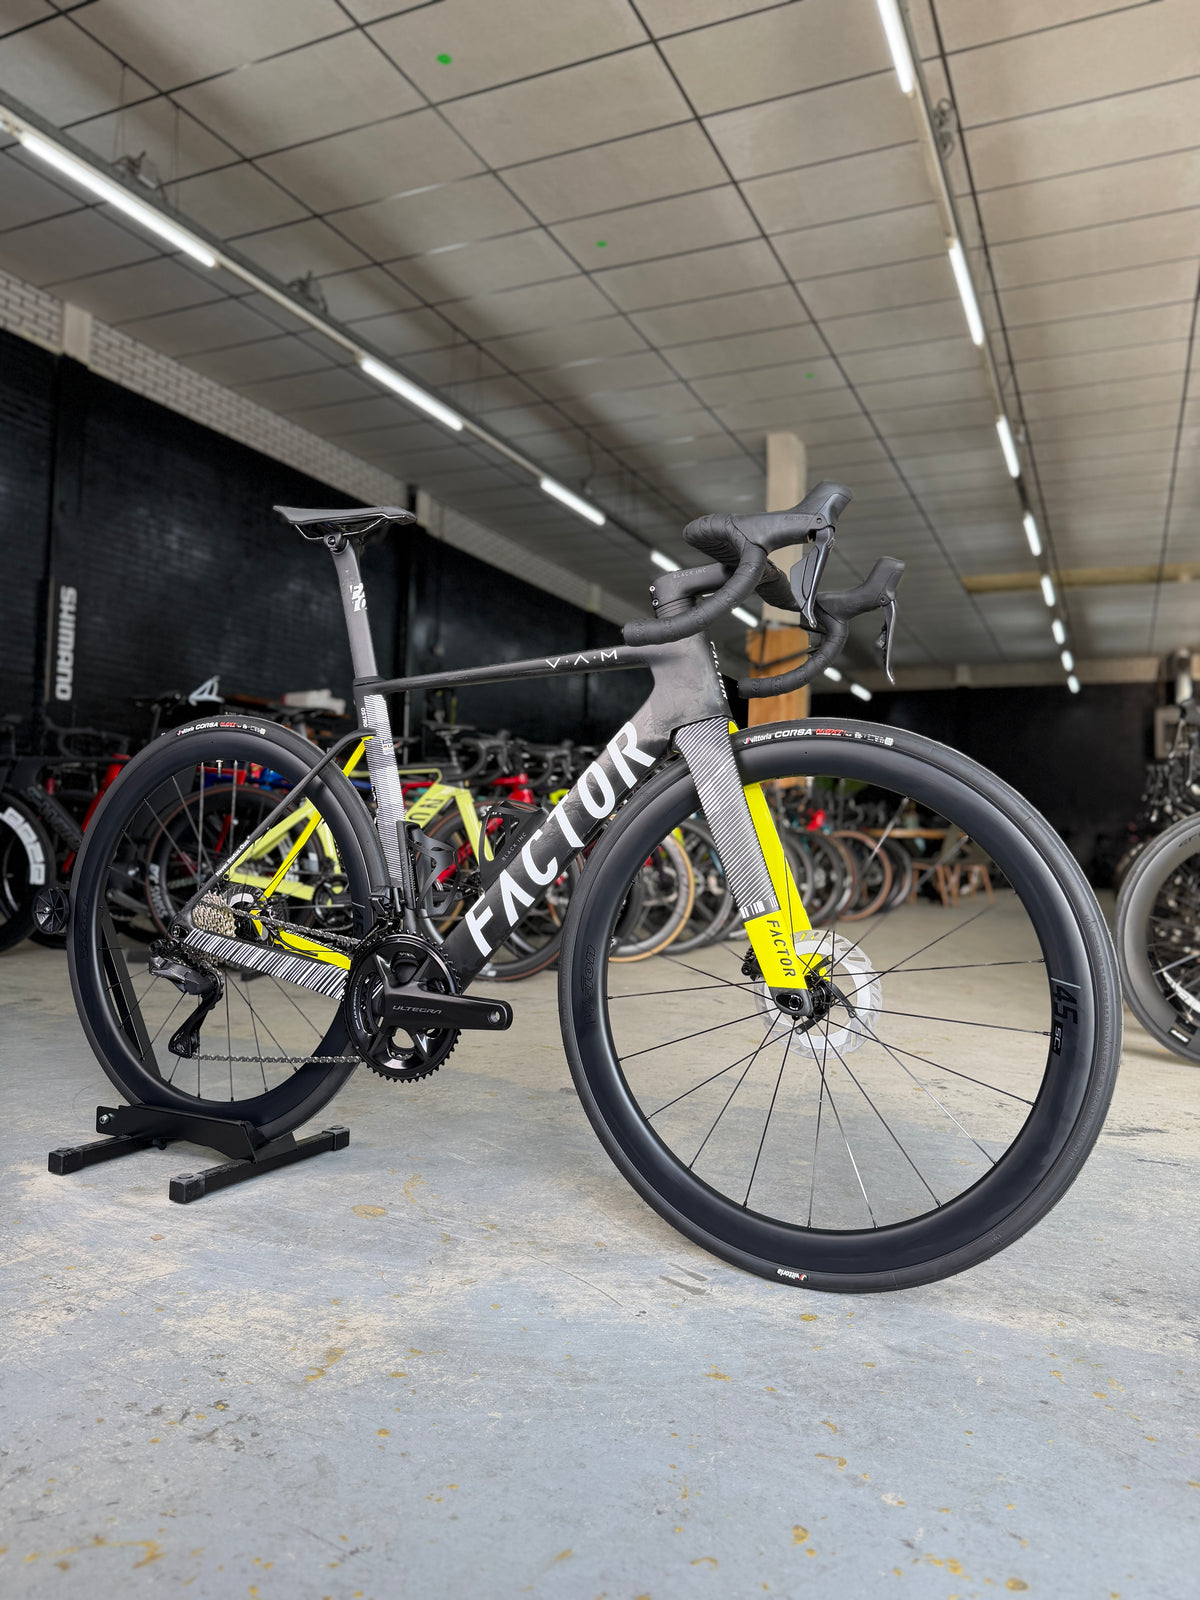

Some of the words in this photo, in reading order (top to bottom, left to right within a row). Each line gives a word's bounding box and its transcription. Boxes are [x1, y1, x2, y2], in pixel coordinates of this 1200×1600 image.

[55, 585, 77, 701] SHIMANO
[195, 721, 219, 730] CORSA
[774, 728, 813, 738] CORSA
[465, 721, 656, 957] FACTOR
[766, 919, 796, 977] FACTOR
[392, 1005, 442, 1015] ULTEGRA
[1055, 985, 1078, 1024] 45
